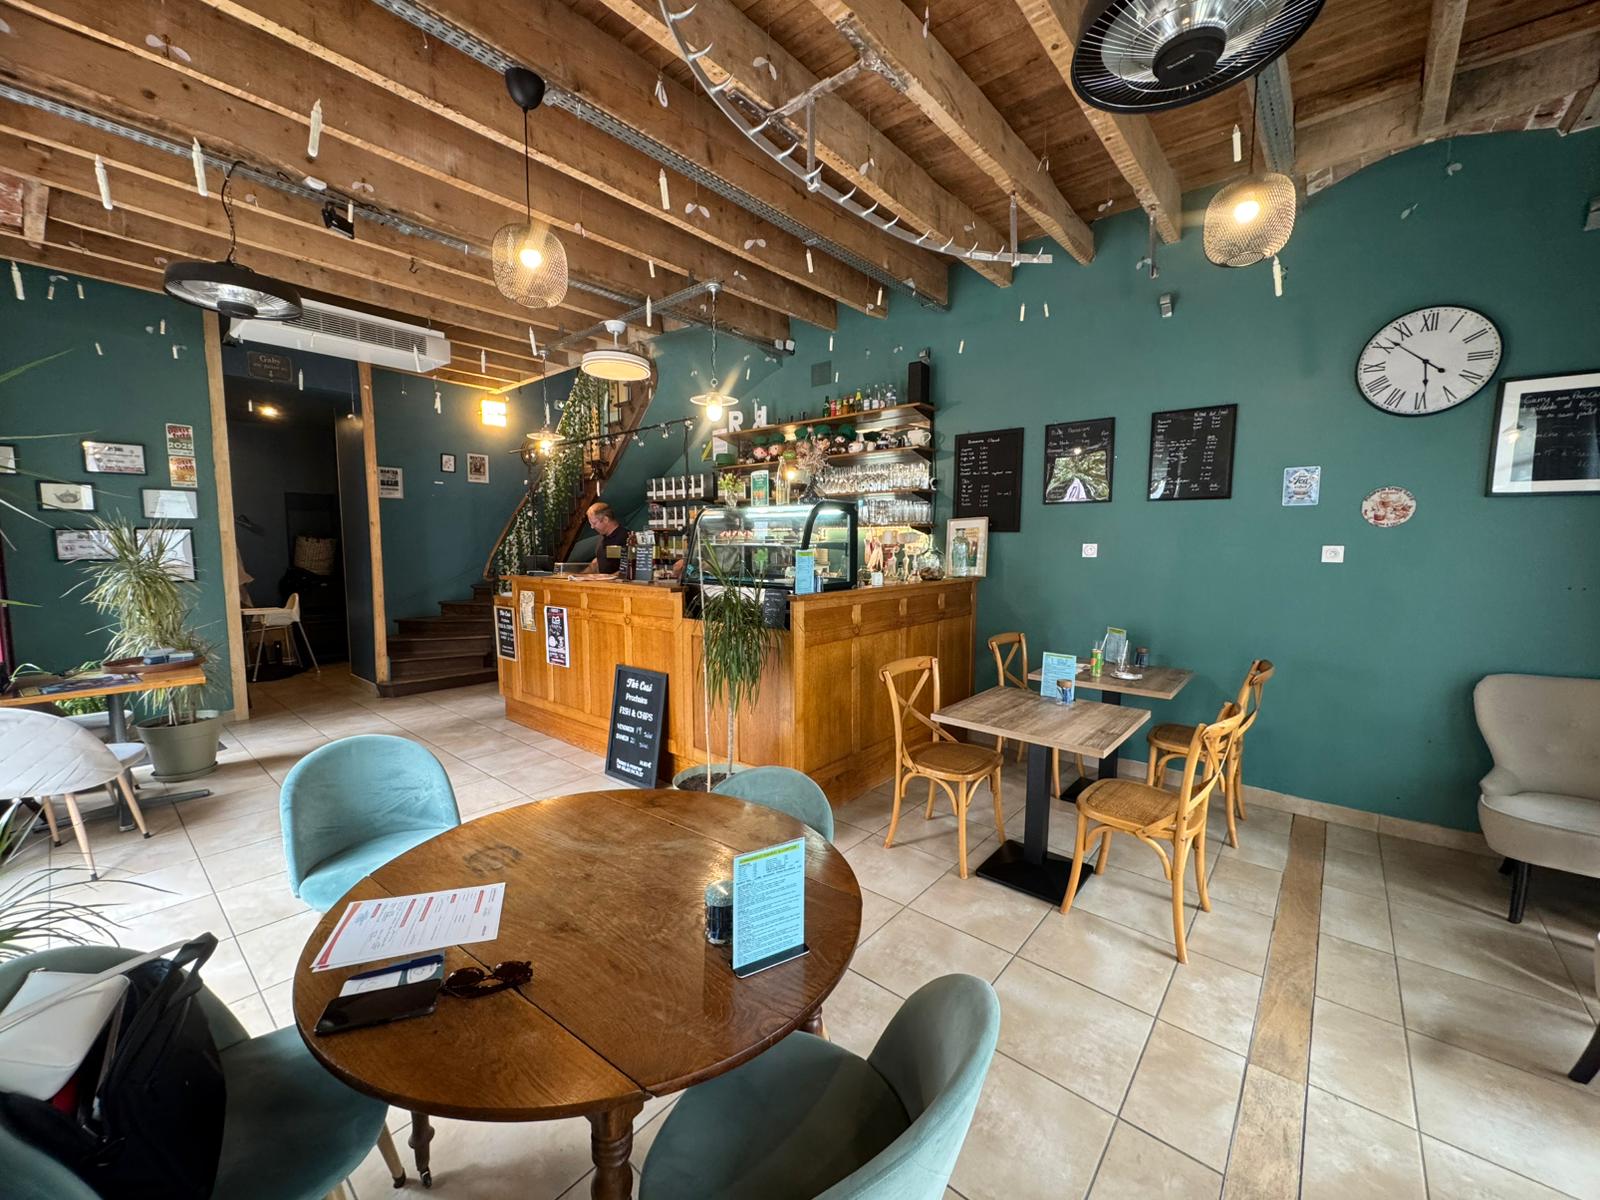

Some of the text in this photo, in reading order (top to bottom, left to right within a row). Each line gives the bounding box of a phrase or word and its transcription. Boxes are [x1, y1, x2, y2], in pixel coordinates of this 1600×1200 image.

[1420, 312, 1440, 333] XII
[1393, 321, 1413, 341] XI
[1462, 328, 1489, 344] II
[1372, 341, 1395, 354] X
[1467, 350, 1494, 361] III
[1363, 361, 1386, 373] IX
[1459, 369, 1484, 385] IV
[1365, 375, 1392, 397] VIII
[1443, 385, 1457, 403] V
[1383, 388, 1406, 408] VII
[1414, 392, 1427, 410] VI
[1293, 477, 1308, 485] Tea
[619, 706, 654, 722] FISH & CHIPS
